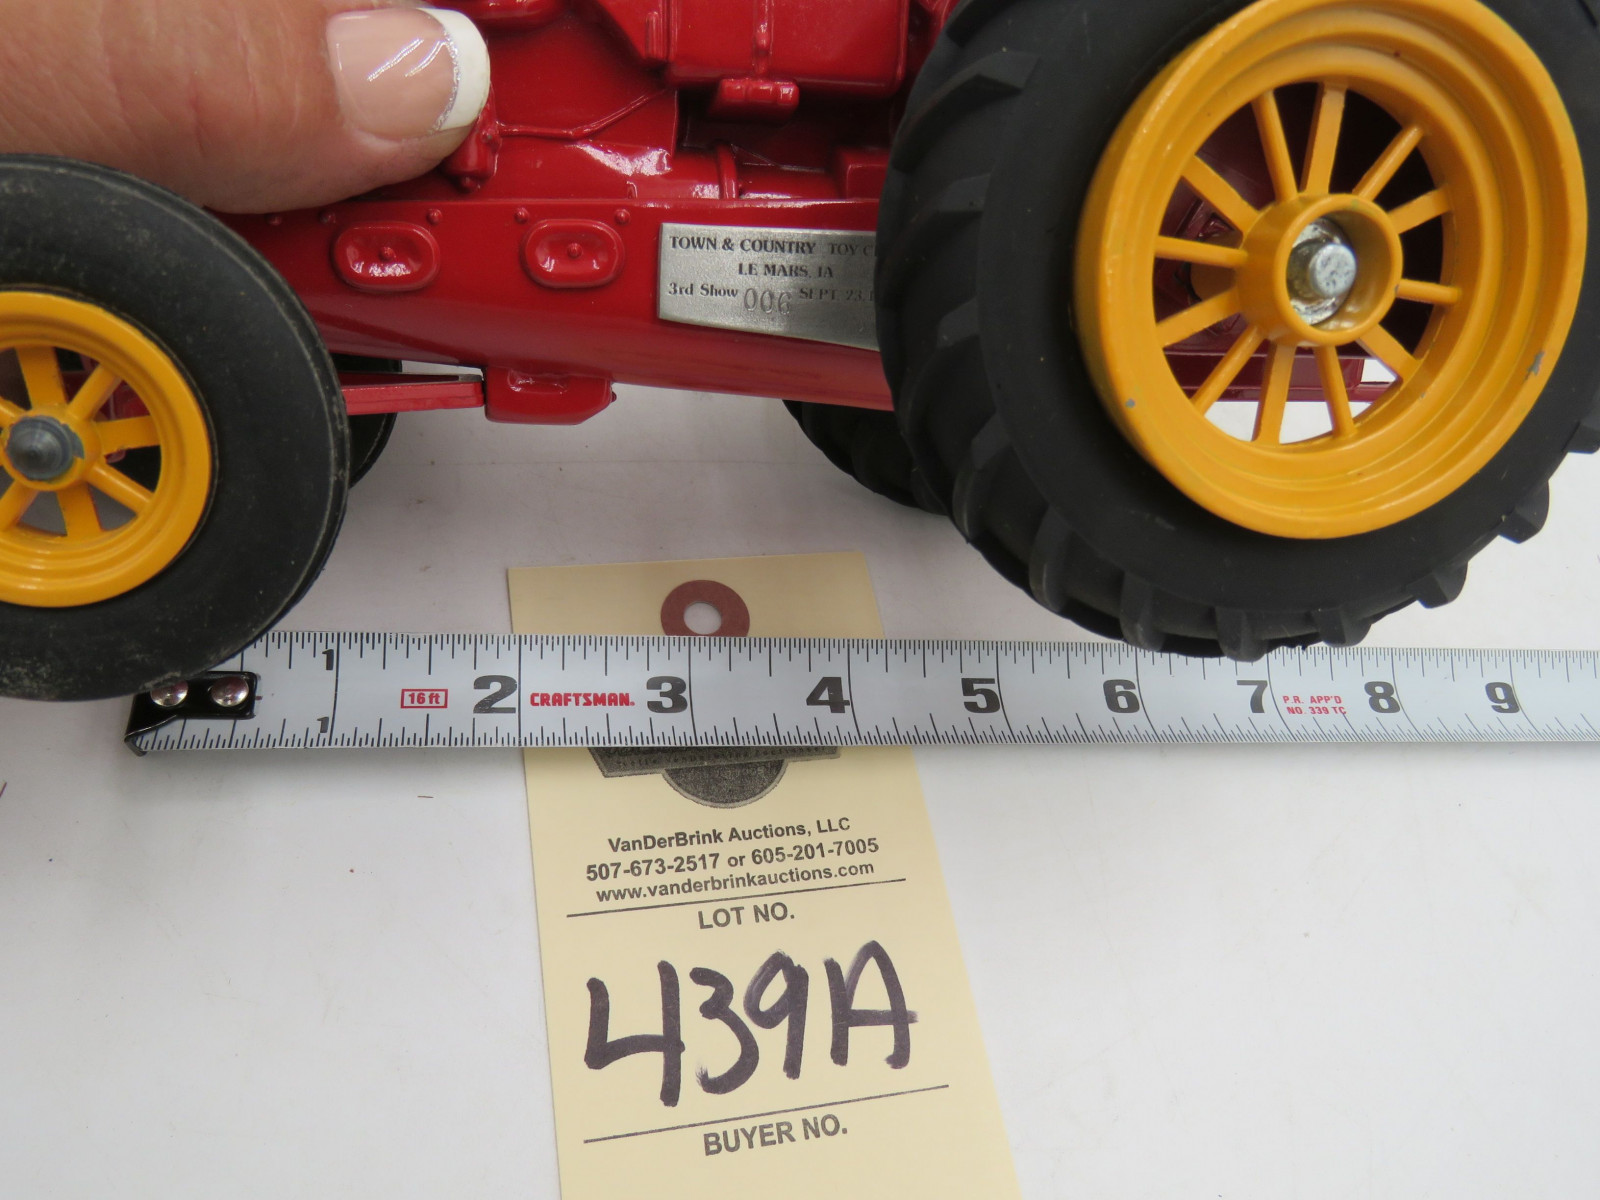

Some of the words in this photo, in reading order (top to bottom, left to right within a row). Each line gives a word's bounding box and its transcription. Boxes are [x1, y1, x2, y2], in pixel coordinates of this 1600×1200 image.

[670, 235, 717, 251] TOWN
[721, 237, 735, 252] &
[739, 238, 817, 255] COUNTRY
[828, 243, 857, 256] TOY
[738, 263, 758, 276] LE
[818, 266, 833, 278] IA
[668, 282, 694, 296] 3rd
[700, 283, 738, 298] Show
[743, 287, 791, 316] 006
[321, 648, 335, 671] 1
[407, 691, 427, 706] 16
[427, 691, 442, 706] ft
[472, 674, 519, 715] 2
[645, 675, 689, 715] 3
[805, 676, 851, 715] 4
[960, 677, 1002, 715] 5
[1102, 679, 1142, 715] 6
[1236, 680, 1269, 715] 7
[1308, 706, 1331, 716] 339
[1331, 706, 1348, 716] TC
[1309, 695, 1343, 705] APP'D
[1363, 681, 1401, 714] 8
[1485, 682, 1520, 714] 9
[316, 716, 331, 734] 1
[607, 829, 724, 853] VanDerBrink
[728, 822, 812, 837] Auctions,
[815, 816, 852, 835] LLC
[586, 853, 721, 882] 507-673-2517
[726, 853, 746, 867] or
[751, 837, 880, 865] 605-201-7005
[595, 861, 875, 903] www.vanderbrinkauctions.com
[697, 907, 745, 930] LOT
[753, 901, 796, 923] NO.
[583, 939, 919, 1108] 439A
[703, 1120, 795, 1157] BUYER
[801, 1113, 849, 1140] NO.
